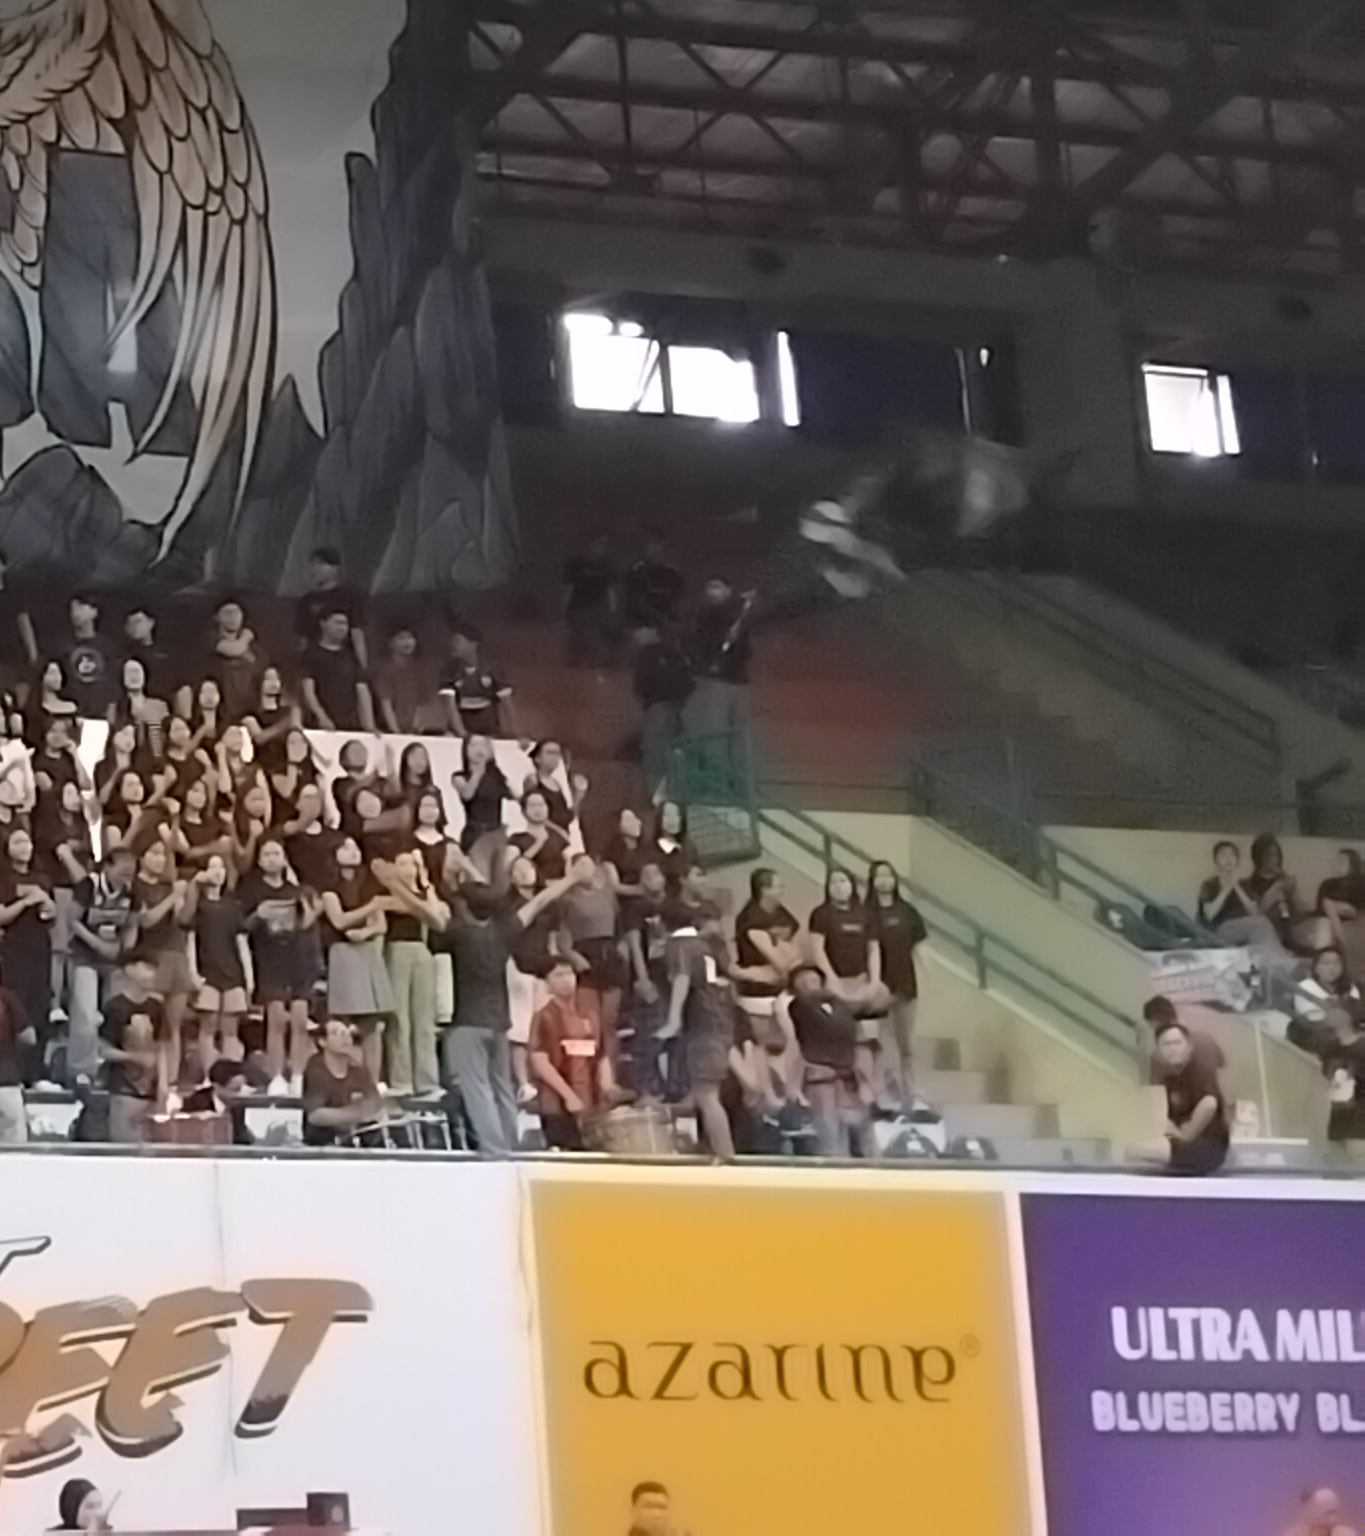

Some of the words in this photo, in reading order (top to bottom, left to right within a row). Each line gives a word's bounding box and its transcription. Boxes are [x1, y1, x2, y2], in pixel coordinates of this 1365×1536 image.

[1110, 1305, 1270, 1362] ULTRA
[1275, 1308, 1365, 1363] MIL
[582, 1339, 957, 1403] azarine
[1090, 1388, 1300, 1433] BLUEBERRY
